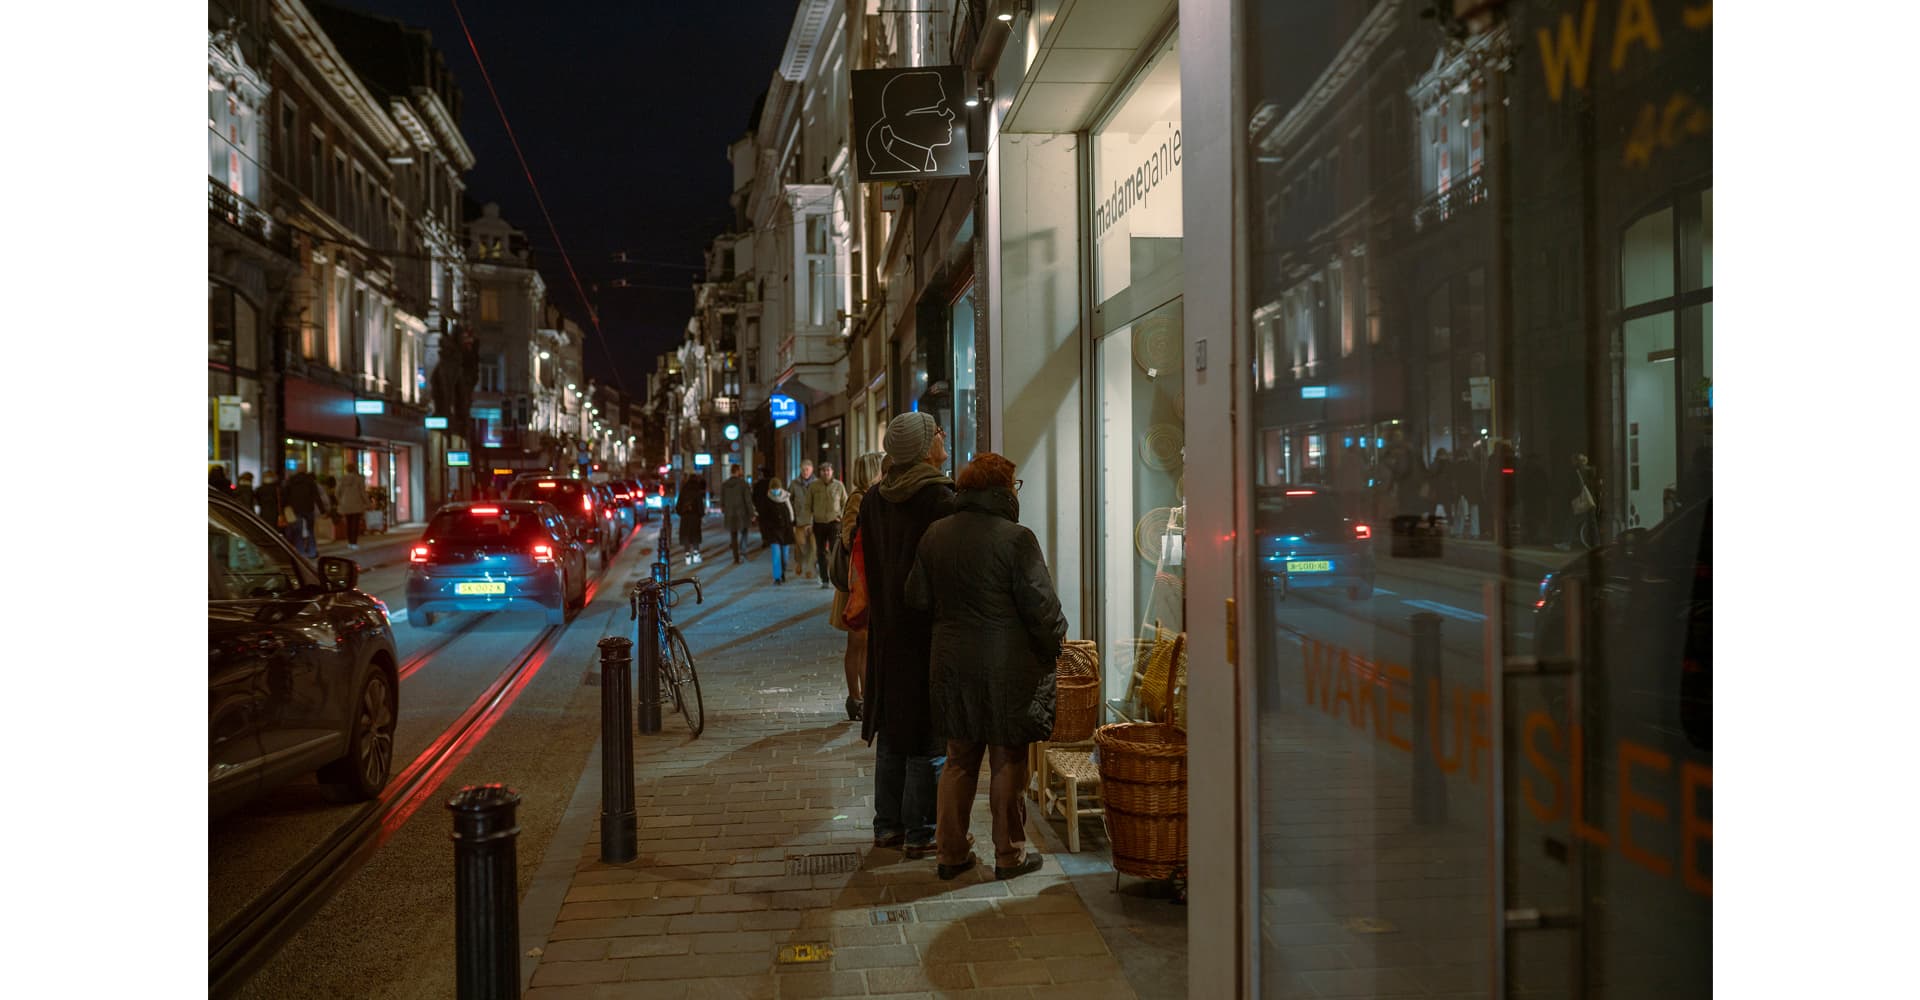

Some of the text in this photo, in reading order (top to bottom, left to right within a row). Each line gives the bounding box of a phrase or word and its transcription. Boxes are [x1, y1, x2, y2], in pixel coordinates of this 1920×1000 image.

[1536, 0, 1712, 103] WA
[1096, 121, 1182, 238] madamepanie
[1302, 637, 1413, 752] WAKE
